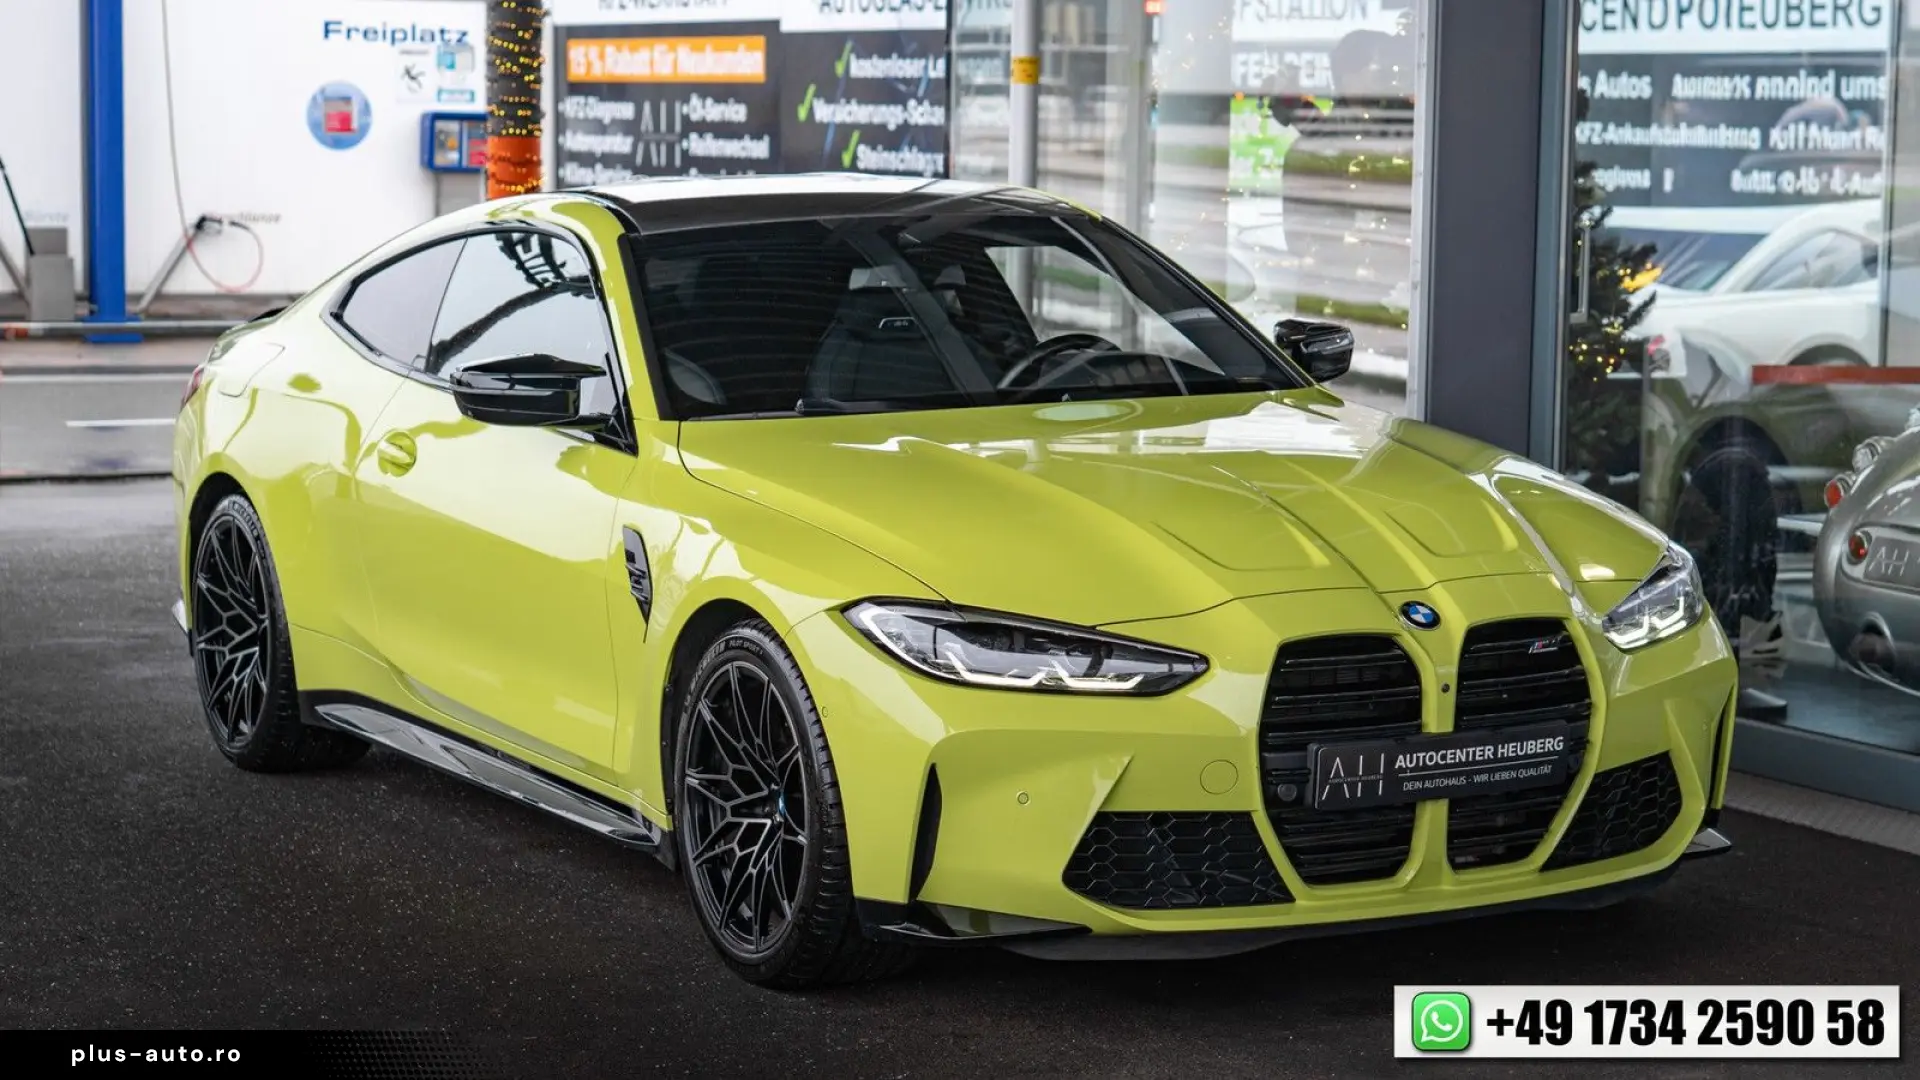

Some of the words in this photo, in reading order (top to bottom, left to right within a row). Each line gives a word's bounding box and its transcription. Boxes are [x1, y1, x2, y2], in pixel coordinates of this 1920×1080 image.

[324, 20, 468, 46] Freiplatz
[604, 43, 651, 75] Rabatt
[652, 43, 675, 75] für
[676, 42, 764, 75] Neukunden
[850, 53, 926, 78] kostenloser
[1594, 69, 1652, 99] Autos
[689, 93, 748, 122] Öl-Service
[689, 132, 770, 159] Reifenwechsel
[1394, 747, 1494, 770] AUTOCENTER
[1497, 736, 1565, 758] HEUBERG
[1321, 752, 1385, 800] AH
[1403, 781, 1423, 792] DEIN
[1424, 776, 1467, 789] AUTOHAUS
[1473, 773, 1489, 785] WIR
[1490, 769, 1517, 783] LIEBEN
[1518, 764, 1552, 779] QUALITÄT
